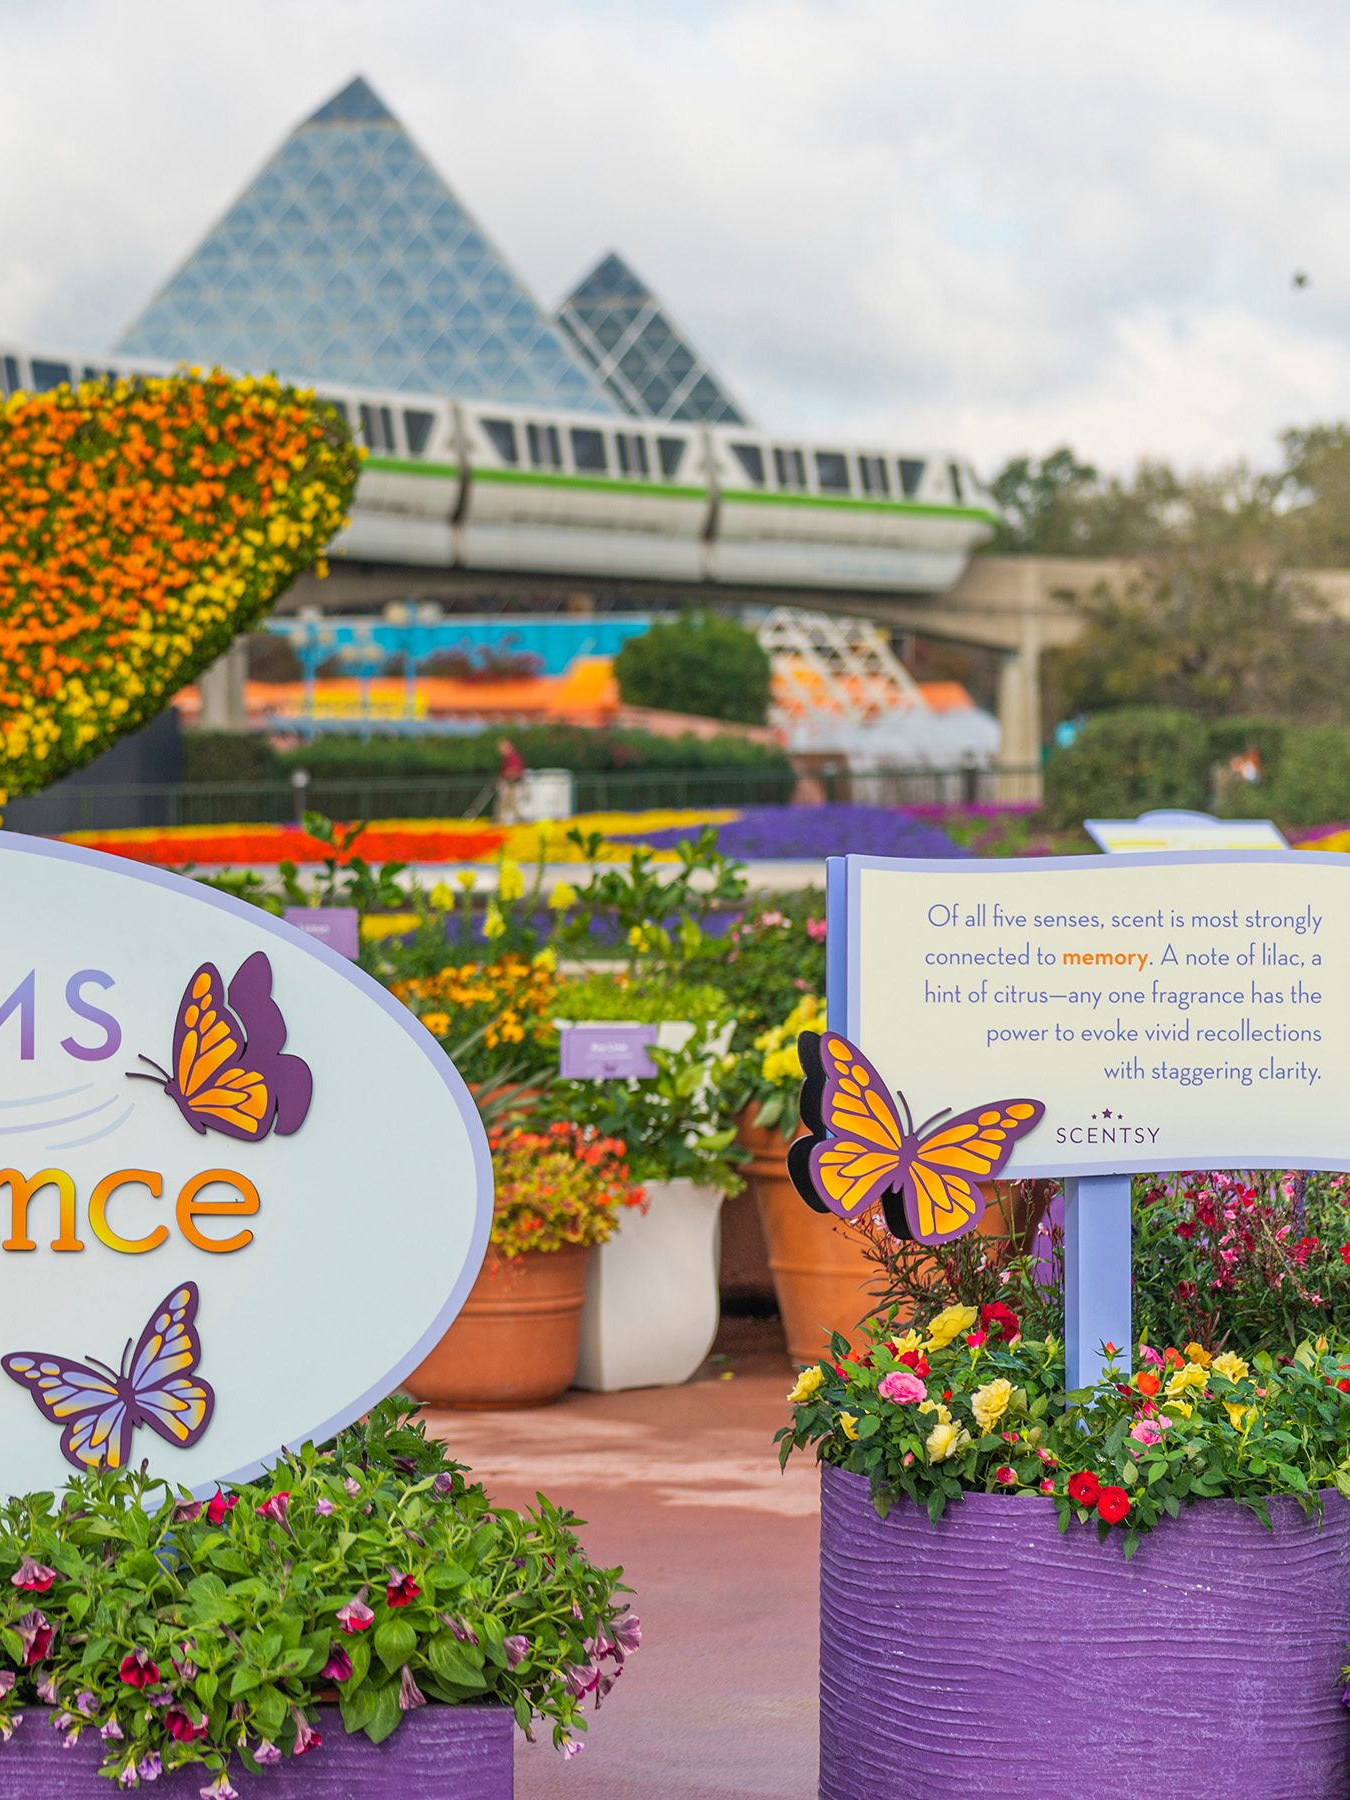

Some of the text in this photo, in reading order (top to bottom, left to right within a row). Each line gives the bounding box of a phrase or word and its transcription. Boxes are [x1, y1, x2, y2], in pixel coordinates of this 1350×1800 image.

[926, 902, 1323, 935] Of all five senses, scent is most strongly
[925, 941, 1322, 973] connected to memory. A note of lilac, a
[925, 979, 962, 1004] hint
[968, 978, 988, 1004] of
[1108, 991, 1146, 1005] one
[1151, 979, 1245, 1011] fragrance
[1251, 979, 1284, 1004] has
[1290, 979, 1322, 1004] the
[986, 1017, 1322, 1048] power to evoke vivid recollections
[1103, 1055, 1322, 1087] with staggering clarity.
[1056, 1127, 1161, 1144] SCENTSY
